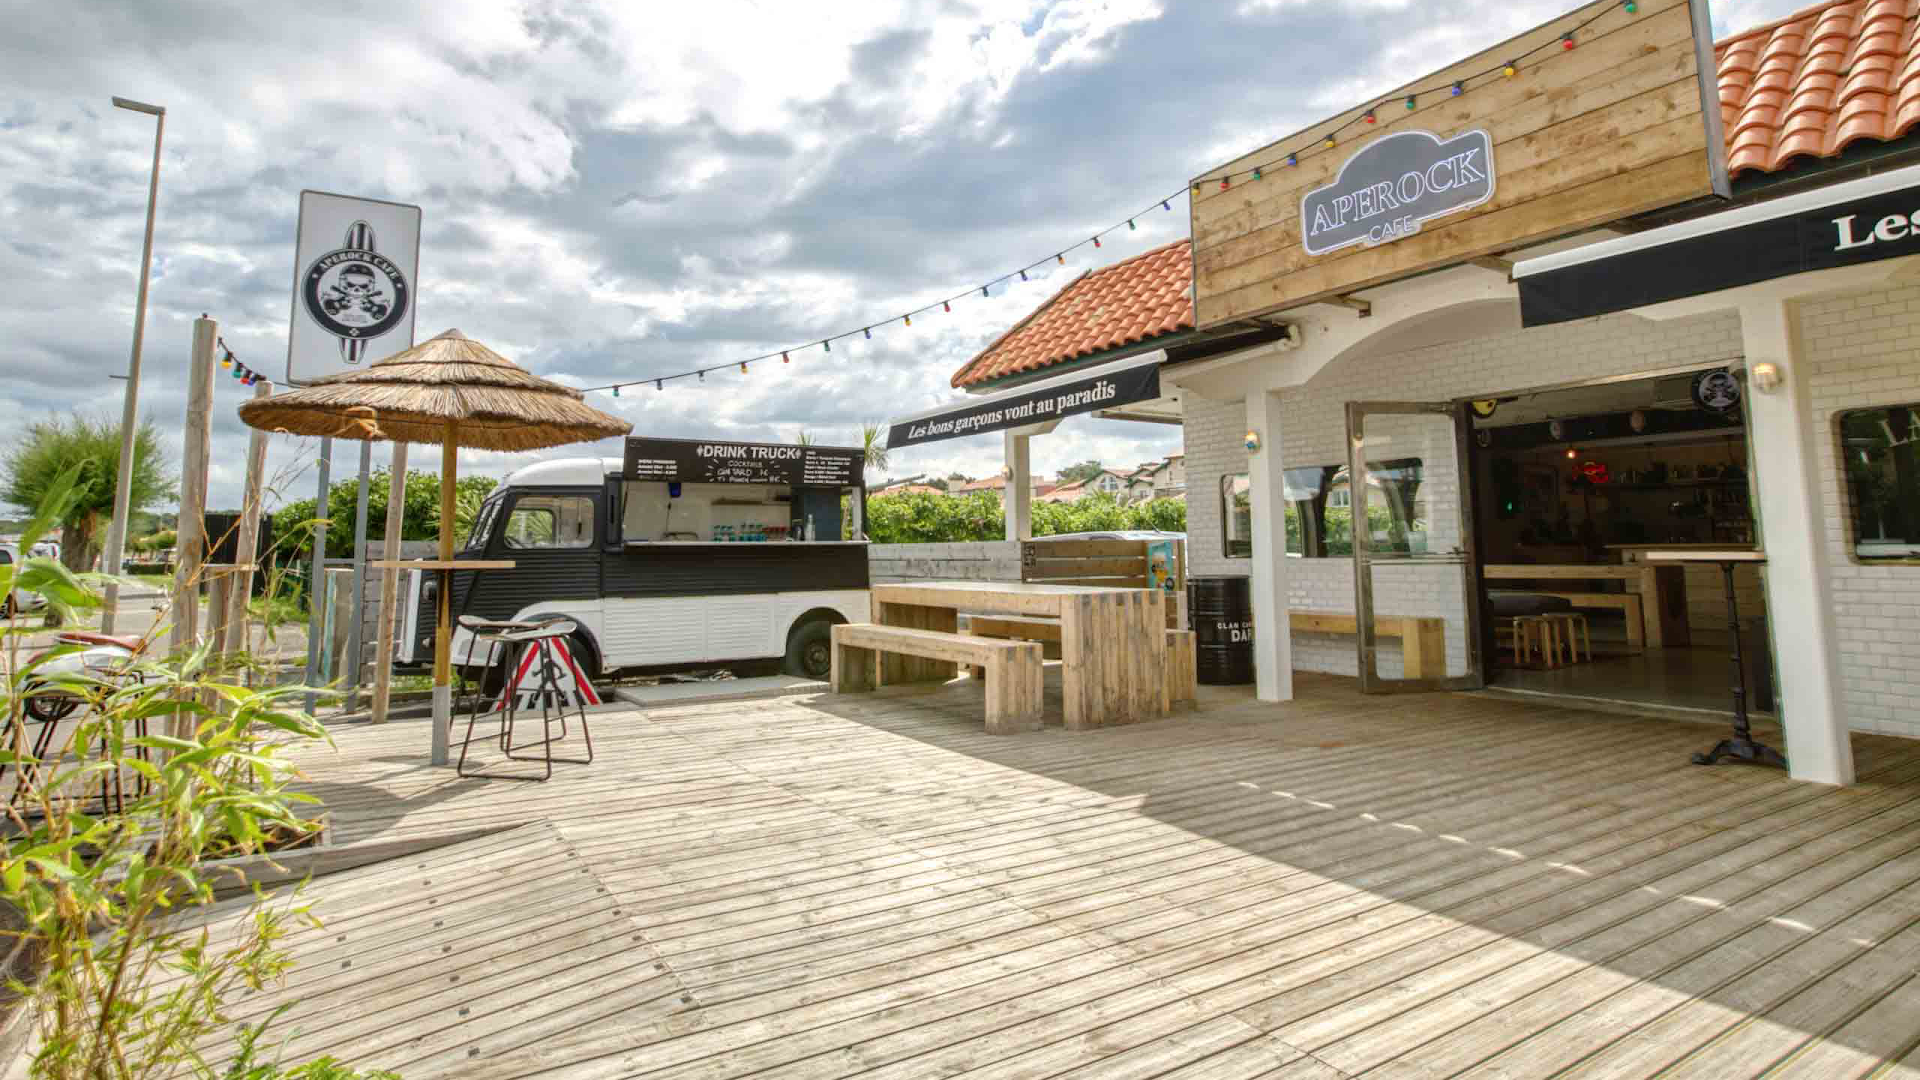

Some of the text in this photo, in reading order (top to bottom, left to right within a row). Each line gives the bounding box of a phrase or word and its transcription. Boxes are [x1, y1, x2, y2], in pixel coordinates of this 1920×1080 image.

[1310, 147, 1485, 236] APEROCK
[1368, 214, 1414, 242] CAFE
[908, 380, 1117, 439] Les bons garçons vont au paradis
[703, 445, 797, 459] DRINK TRUCK
[1217, 621, 1239, 629] CLAN
